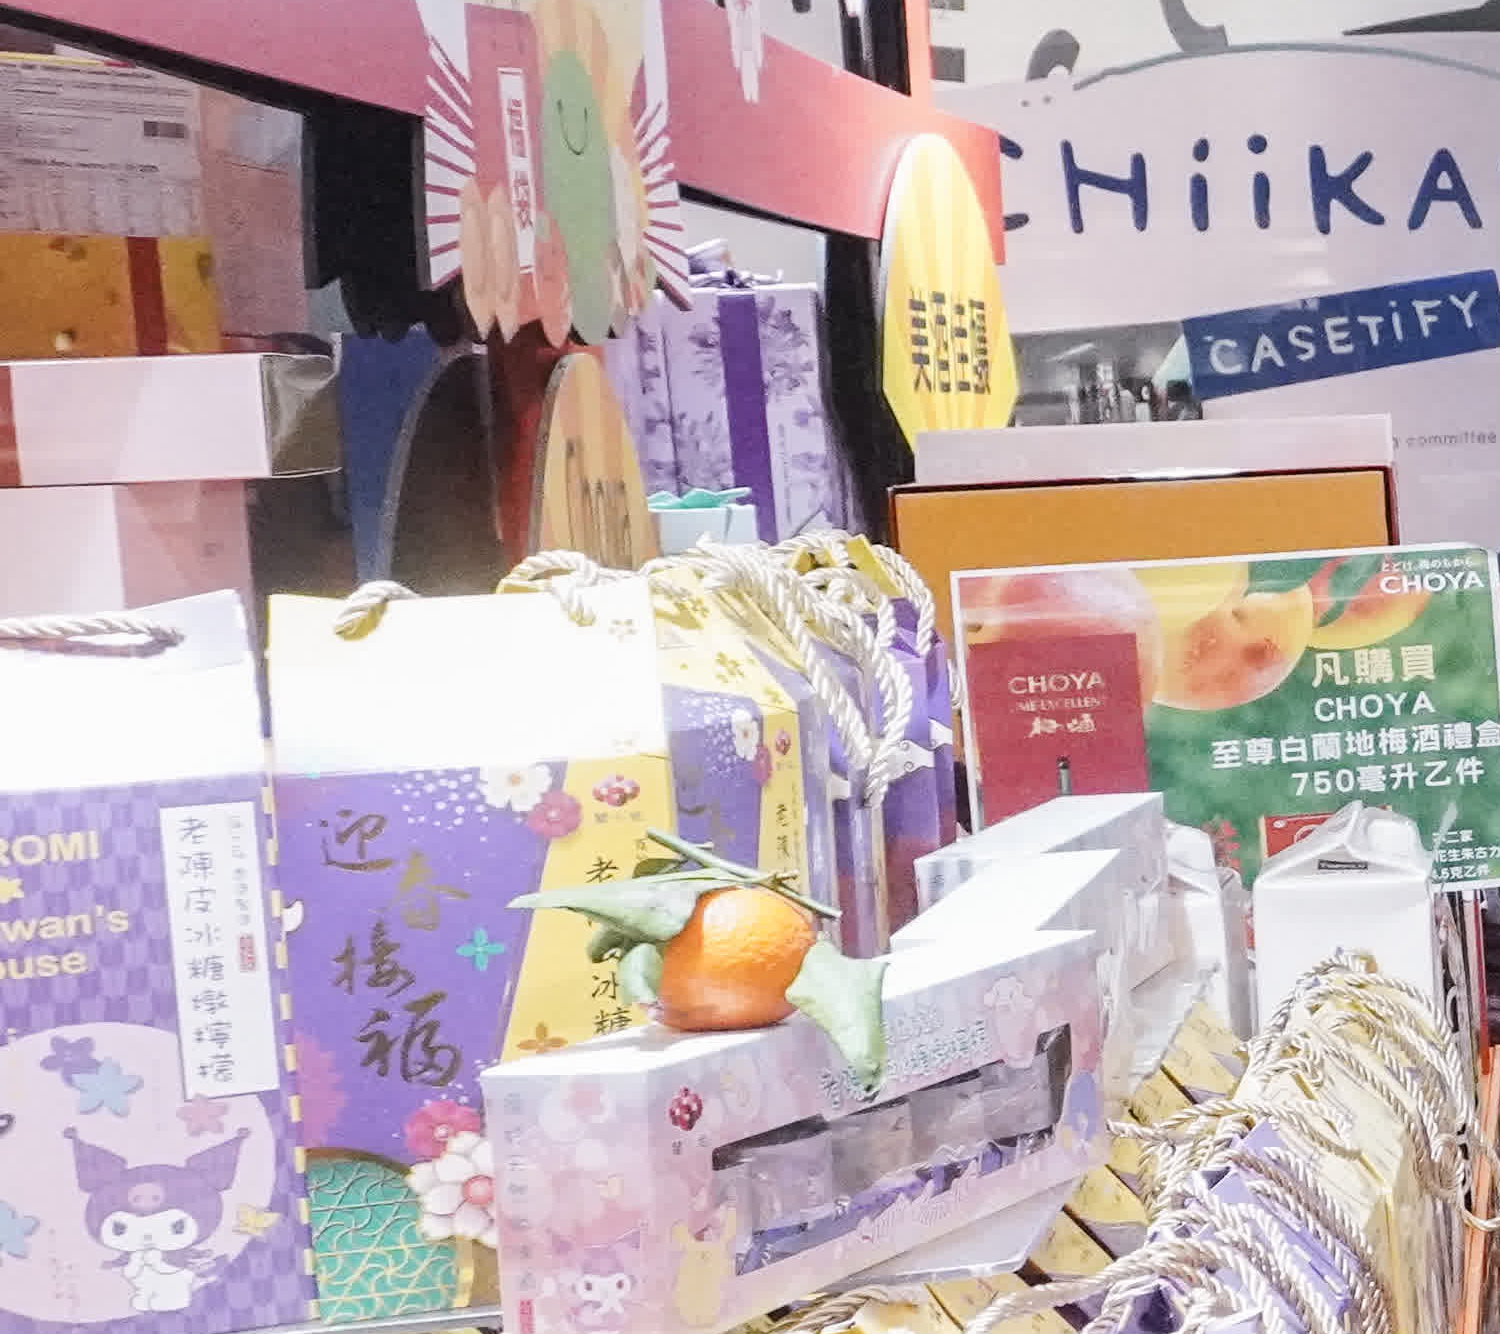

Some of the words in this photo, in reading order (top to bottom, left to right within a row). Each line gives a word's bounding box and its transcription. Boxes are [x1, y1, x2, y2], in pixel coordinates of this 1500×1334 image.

[1379, 570, 1485, 595] CHOYA
[1311, 643, 1437, 688] 凡購買
[1008, 671, 1105, 695] CHOYA
[1313, 690, 1437, 723] CHOYA
[1290, 758, 1486, 798] 750毫升乙件
